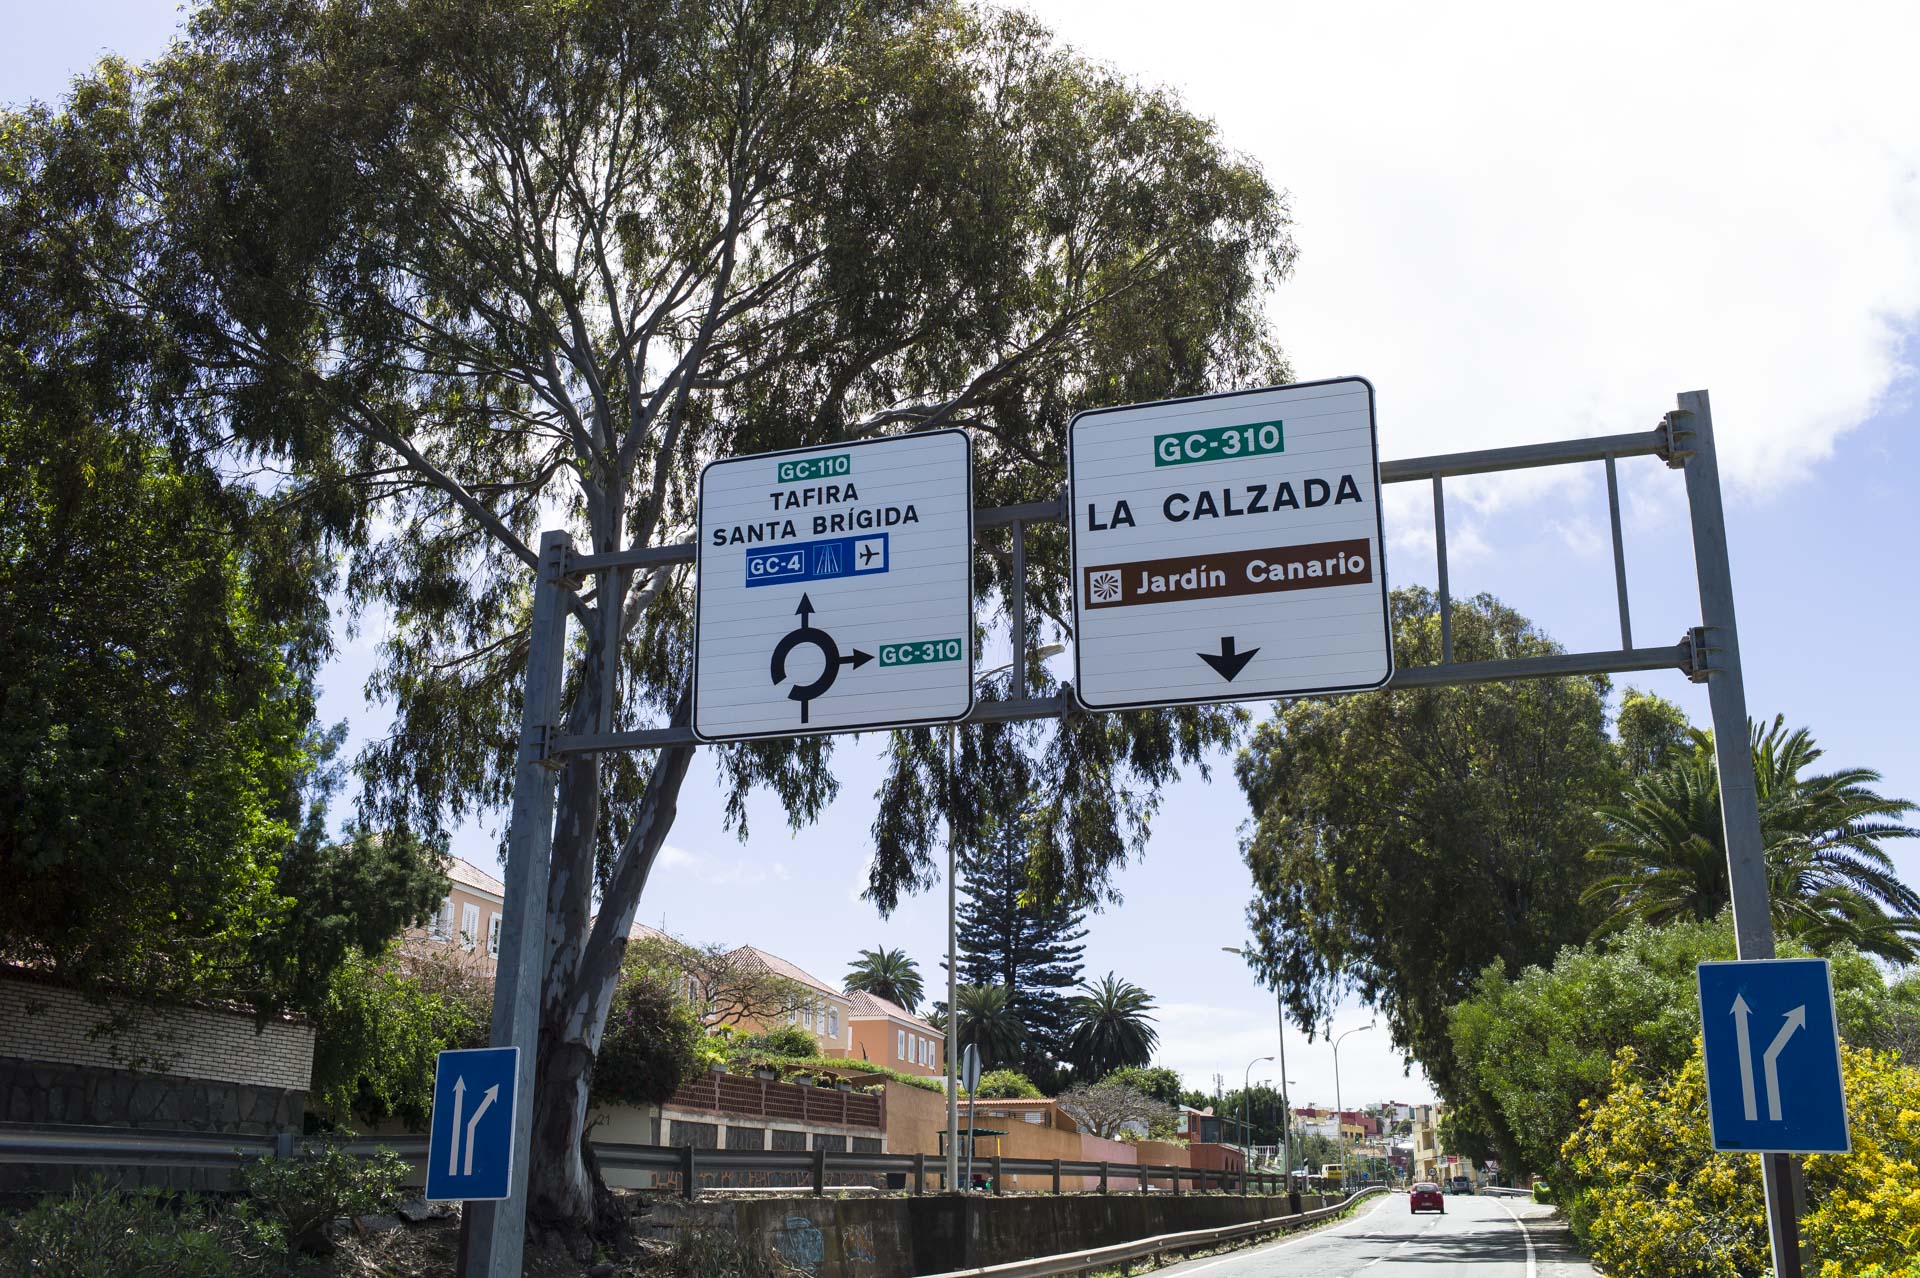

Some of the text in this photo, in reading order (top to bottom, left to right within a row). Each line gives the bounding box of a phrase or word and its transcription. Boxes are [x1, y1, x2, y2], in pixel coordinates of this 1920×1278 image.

[1158, 425, 1280, 462] GC-310
[780, 457, 848, 480] GC-110
[769, 483, 859, 511] TAFIRA
[1088, 474, 1363, 532] LA CALZADA
[712, 504, 920, 547] SANTA BRÍGIDA
[750, 555, 801, 575] GC-4
[1136, 551, 1366, 595] Jardín Canario
[881, 641, 959, 664] GC-310
